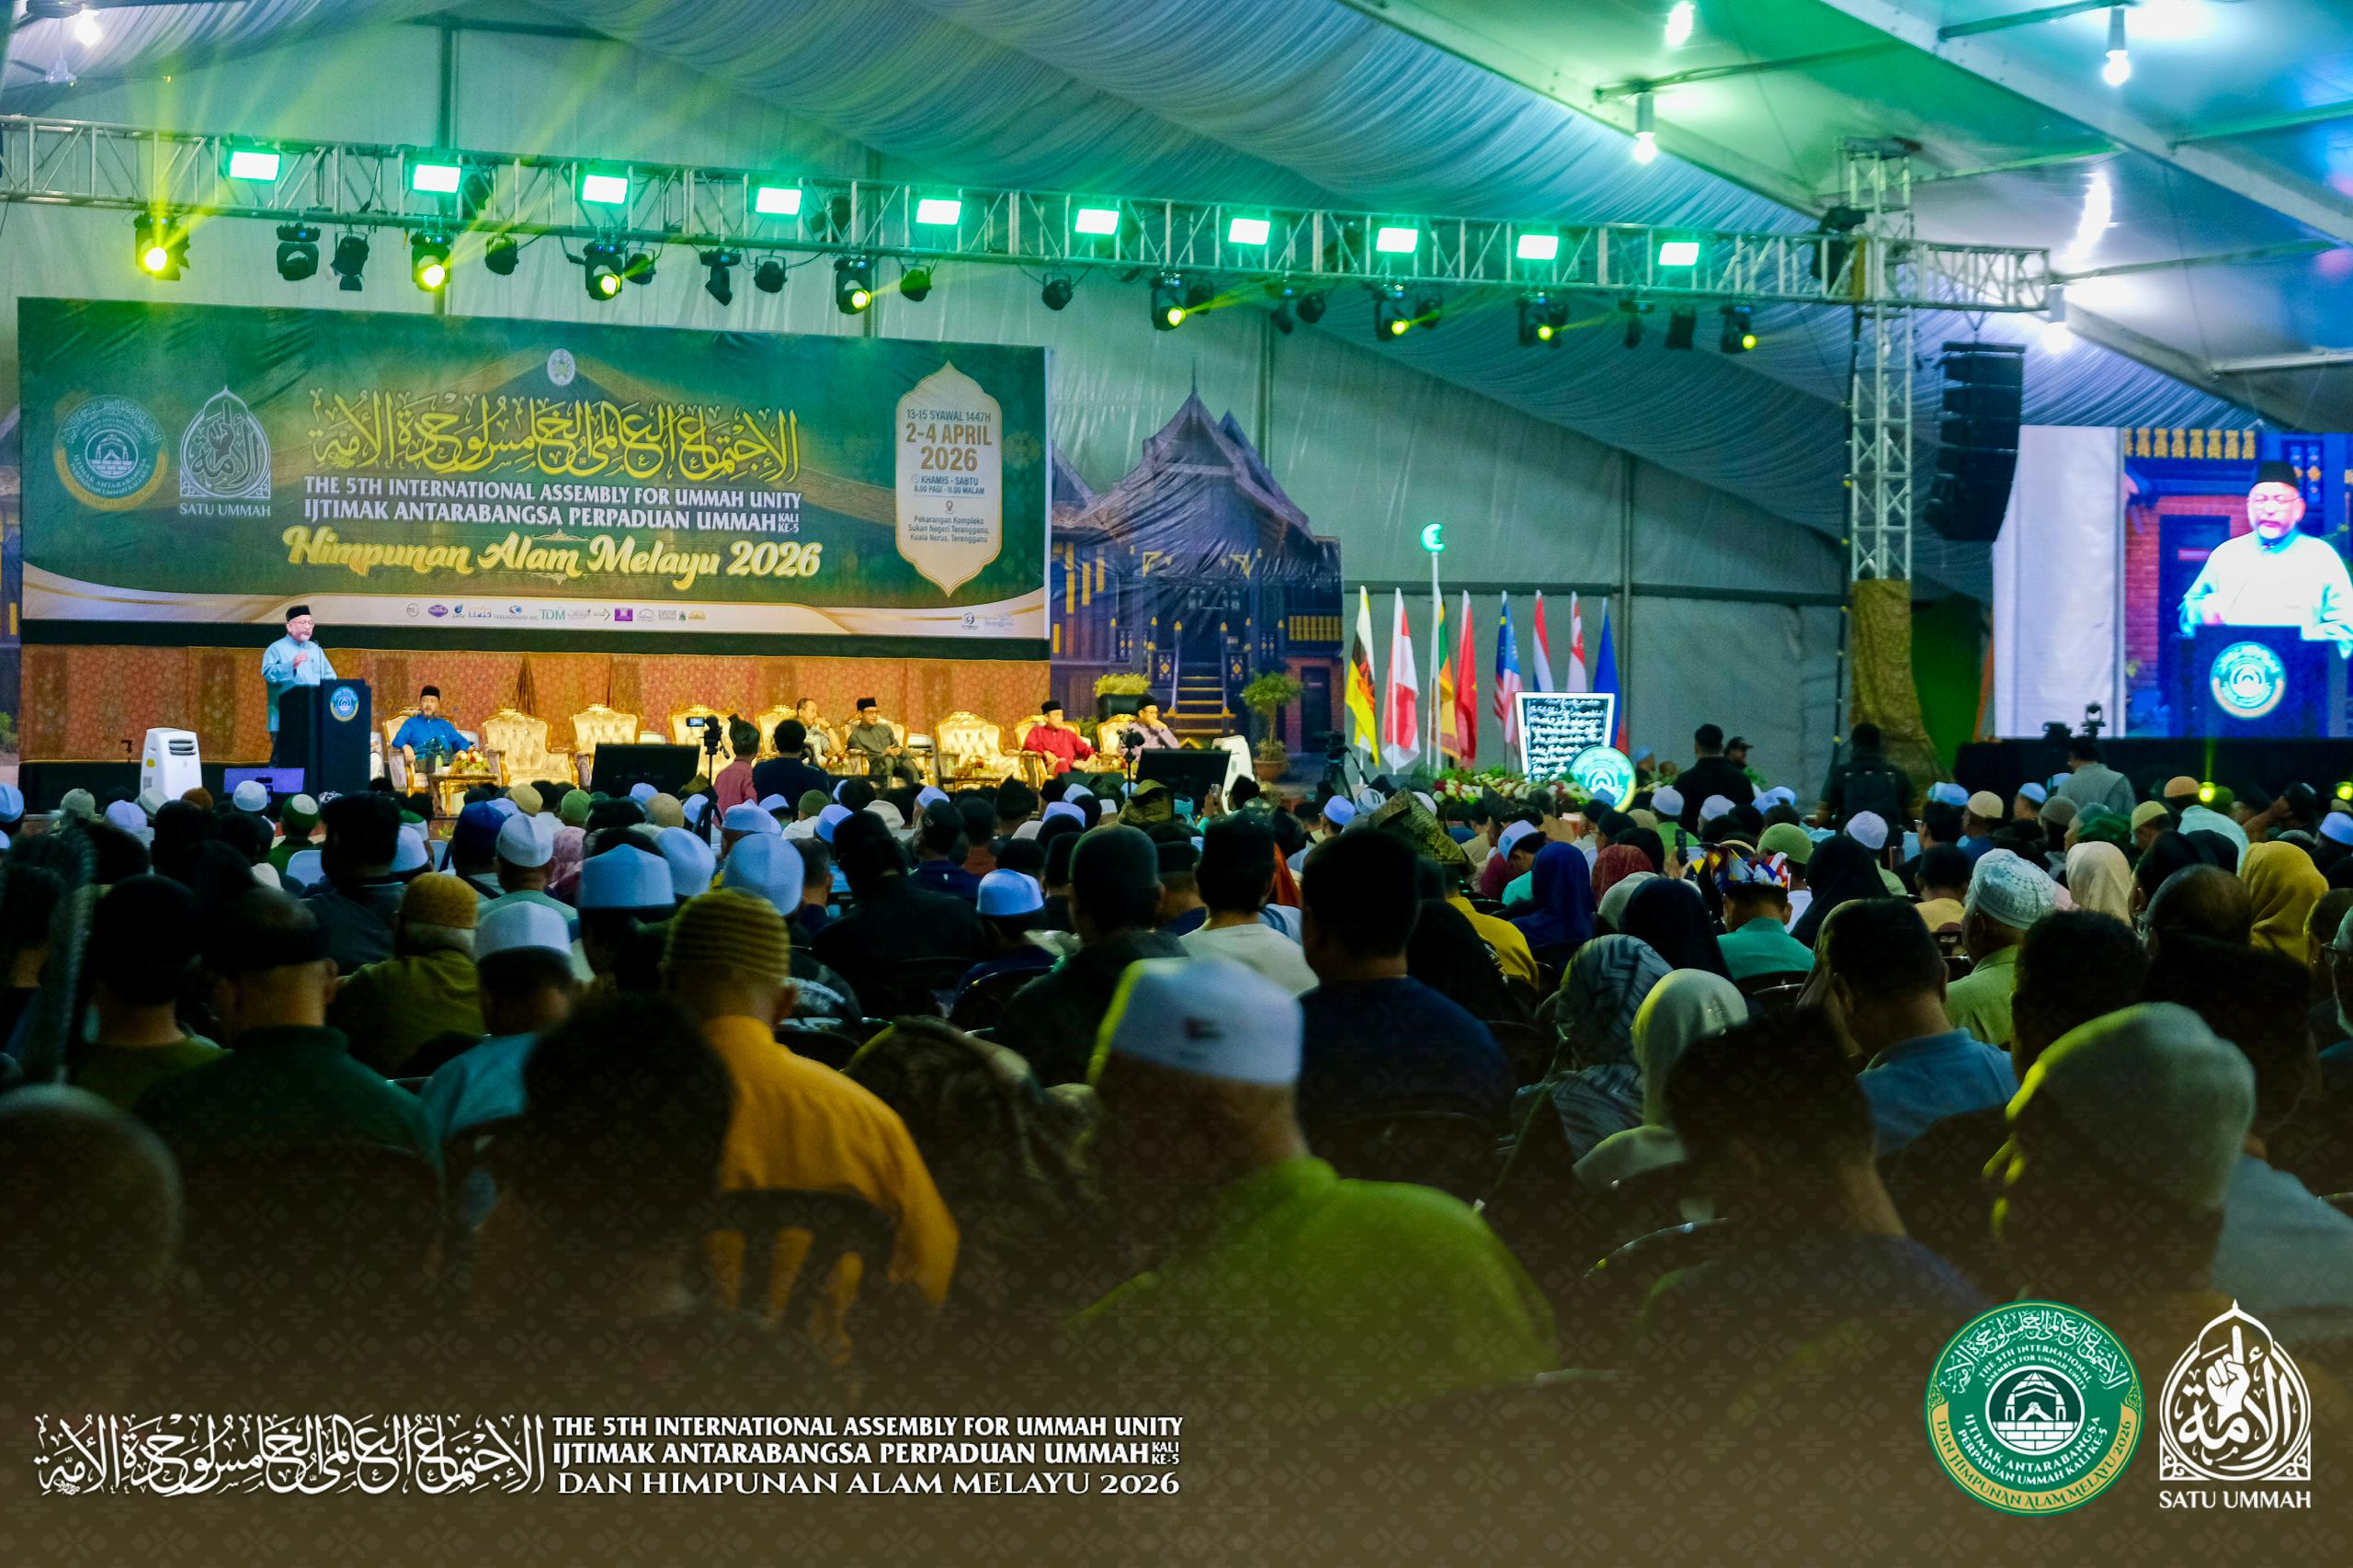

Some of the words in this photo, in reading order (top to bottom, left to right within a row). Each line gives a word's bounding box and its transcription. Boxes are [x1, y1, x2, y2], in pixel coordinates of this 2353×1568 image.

[930, 410, 963, 421] SYAWAL
[966, 412, 991, 422] 1447H
[906, 422, 936, 443] 2-4
[941, 424, 992, 445] APRIL
[920, 446, 977, 471] 2026
[921, 475, 949, 484] KHAMIS
[955, 476, 978, 485] SABTU
[304, 476, 339, 494] THE
[347, 477, 382, 495] 5TH
[389, 479, 535, 500] INTERNATIONAL
[540, 483, 630, 505] ASSEMBLY
[635, 487, 670, 506] FOR
[676, 489, 744, 507] UMMAH
[749, 492, 801, 509] UNITY
[180, 503, 213, 515] SATU
[218, 504, 271, 517] UMMAH
[304, 499, 389, 522] IJTIMAK
[394, 502, 563, 525] ANTARABANGSA
[568, 508, 690, 529] PERPADUAN
[697, 511, 777, 532] UMMAH
[779, 513, 799, 523] KALI
[914, 515, 952, 525] Pekarangan
[953, 517, 984, 525] Kompleks
[779, 522, 800, 533] KE-5
[908, 524, 927, 532] Sukan
[929, 525, 950, 533] Negeri
[910, 533, 927, 541] Kuala
[281, 525, 475, 576] Himpunan
[477, 530, 584, 579] Alam
[586, 535, 721, 591] Melayu
[726, 540, 824, 577] 2026
[540, 609, 565, 620] TDM
